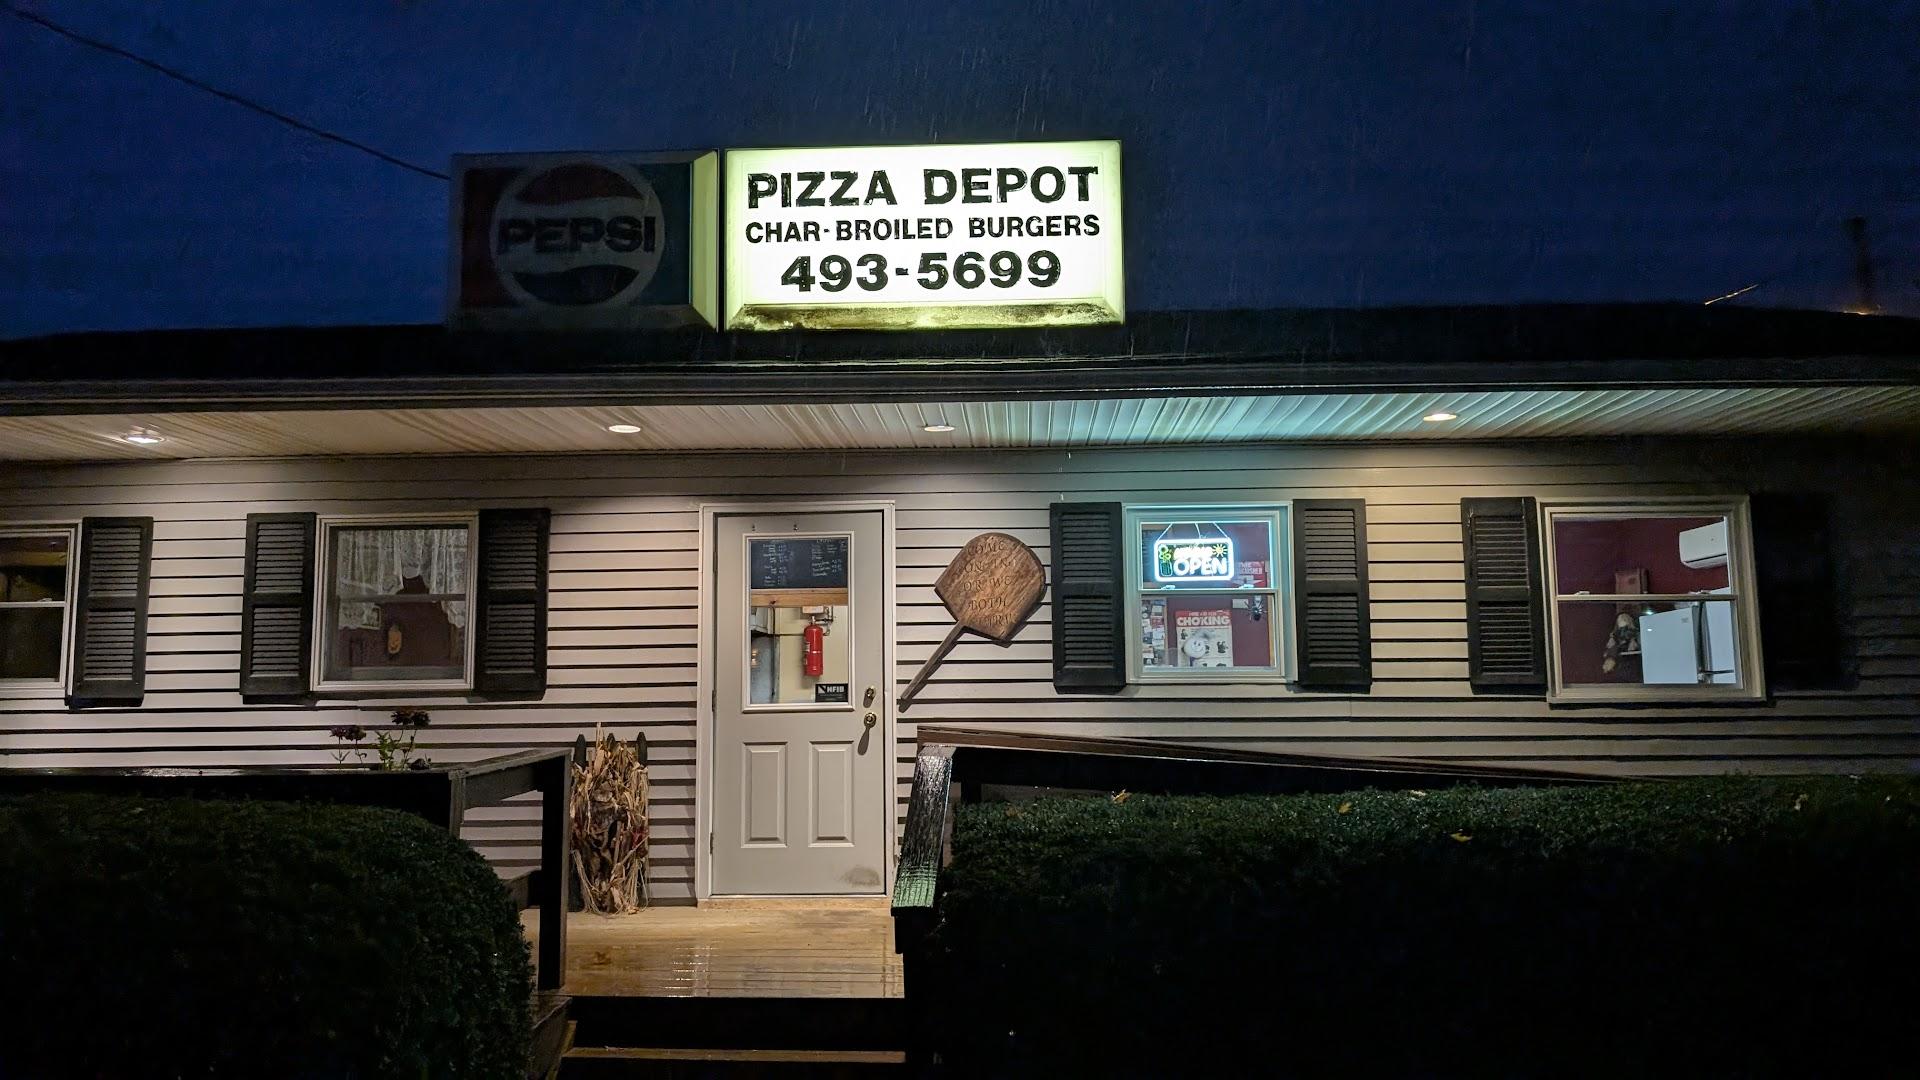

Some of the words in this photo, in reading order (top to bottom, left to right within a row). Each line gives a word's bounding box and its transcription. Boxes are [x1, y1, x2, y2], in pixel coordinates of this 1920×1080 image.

[747, 171, 898, 209] PIZZA
[923, 165, 1098, 205] DEPOT
[499, 215, 656, 253] PEPSI
[968, 214, 1100, 238] BURGERS
[781, 249, 1061, 292] 493-5699
[1173, 558, 1228, 576] OPEN
[1177, 616, 1231, 626] CHOKING
